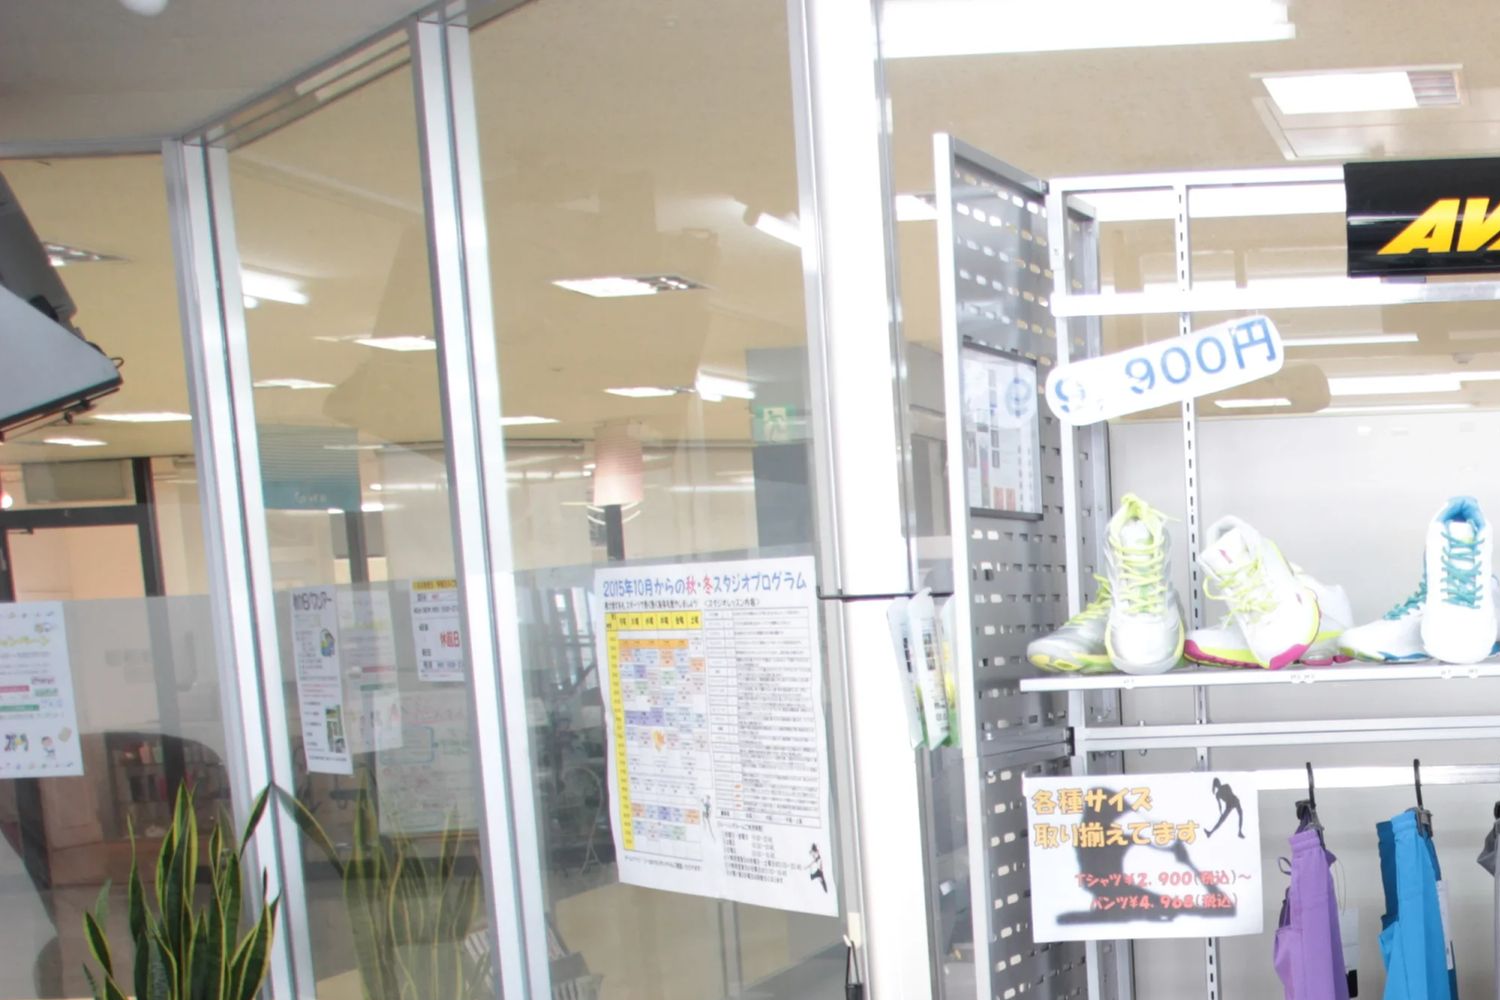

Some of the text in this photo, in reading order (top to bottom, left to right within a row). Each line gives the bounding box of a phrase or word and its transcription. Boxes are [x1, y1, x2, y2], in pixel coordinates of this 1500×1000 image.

[1032, 787, 1153, 815] 各種サイズ
[1033, 820, 1200, 849] 取り揃えてます
